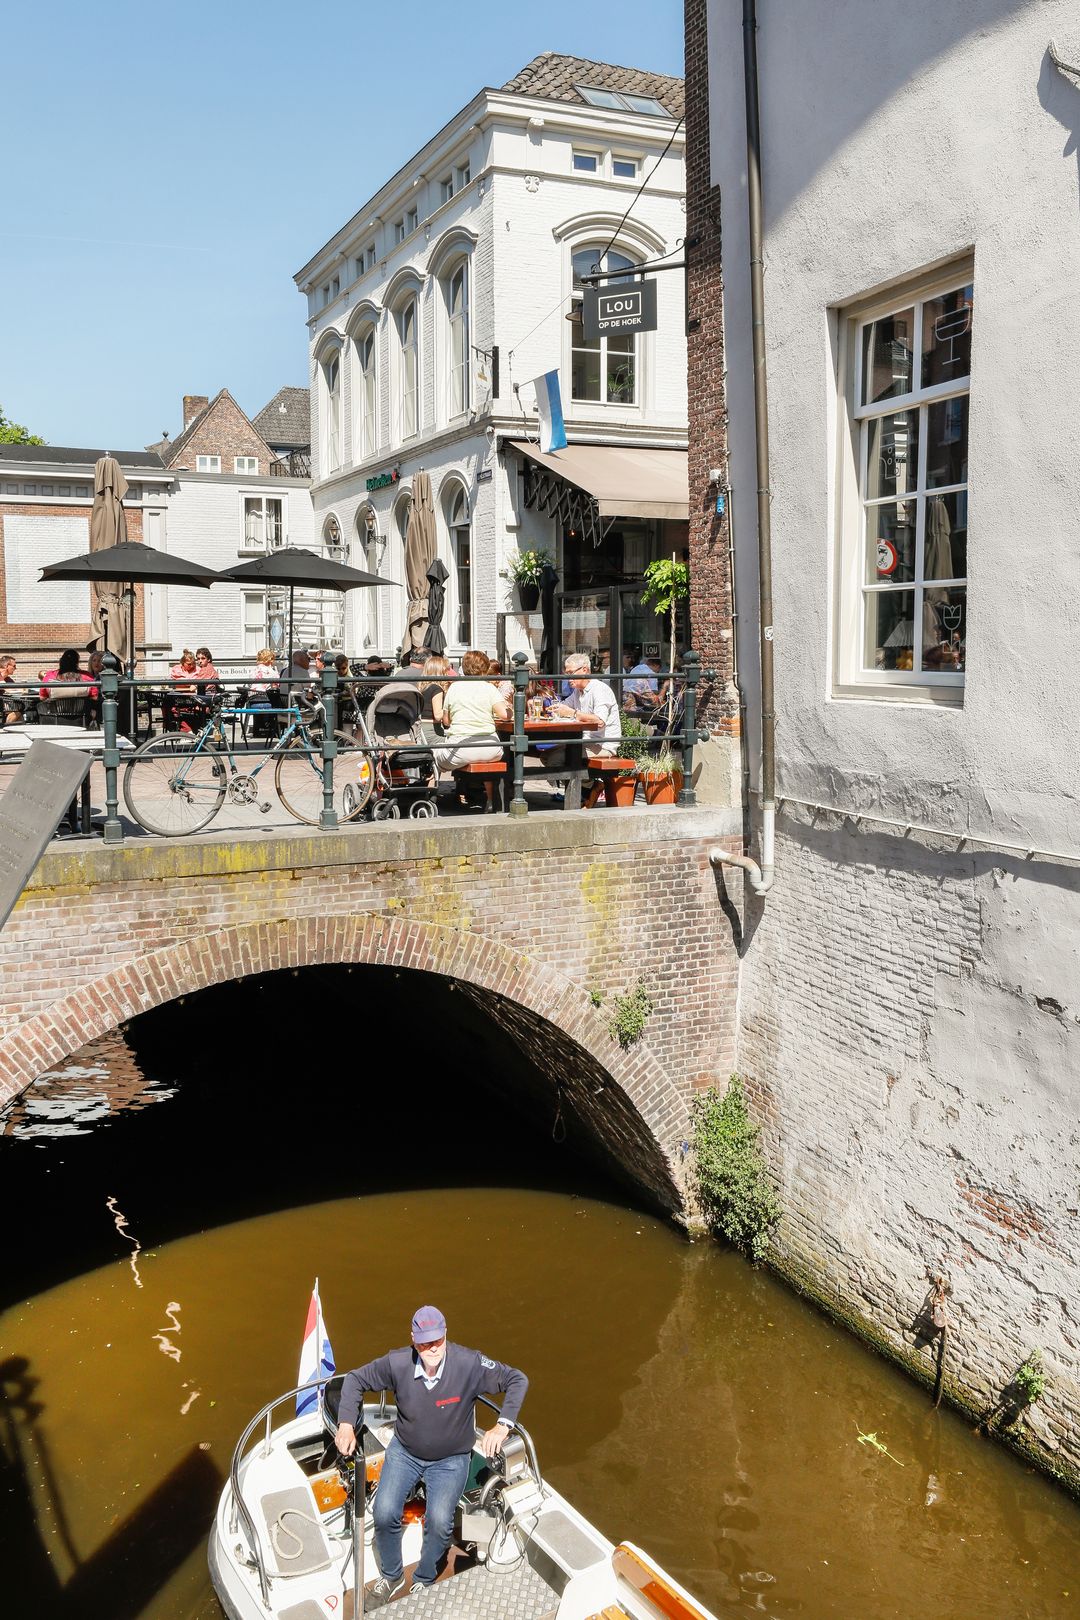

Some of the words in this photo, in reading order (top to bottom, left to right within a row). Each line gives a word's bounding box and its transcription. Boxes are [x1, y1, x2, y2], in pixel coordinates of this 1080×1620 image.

[606, 299, 633, 313] LOU
[598, 321, 610, 329] OP
[610, 319, 621, 328] DE
[621, 317, 642, 326] HOEK
[645, 645, 658, 654] LOU
[216, 667, 229, 675] Den
[230, 667, 248, 675] Bosch
